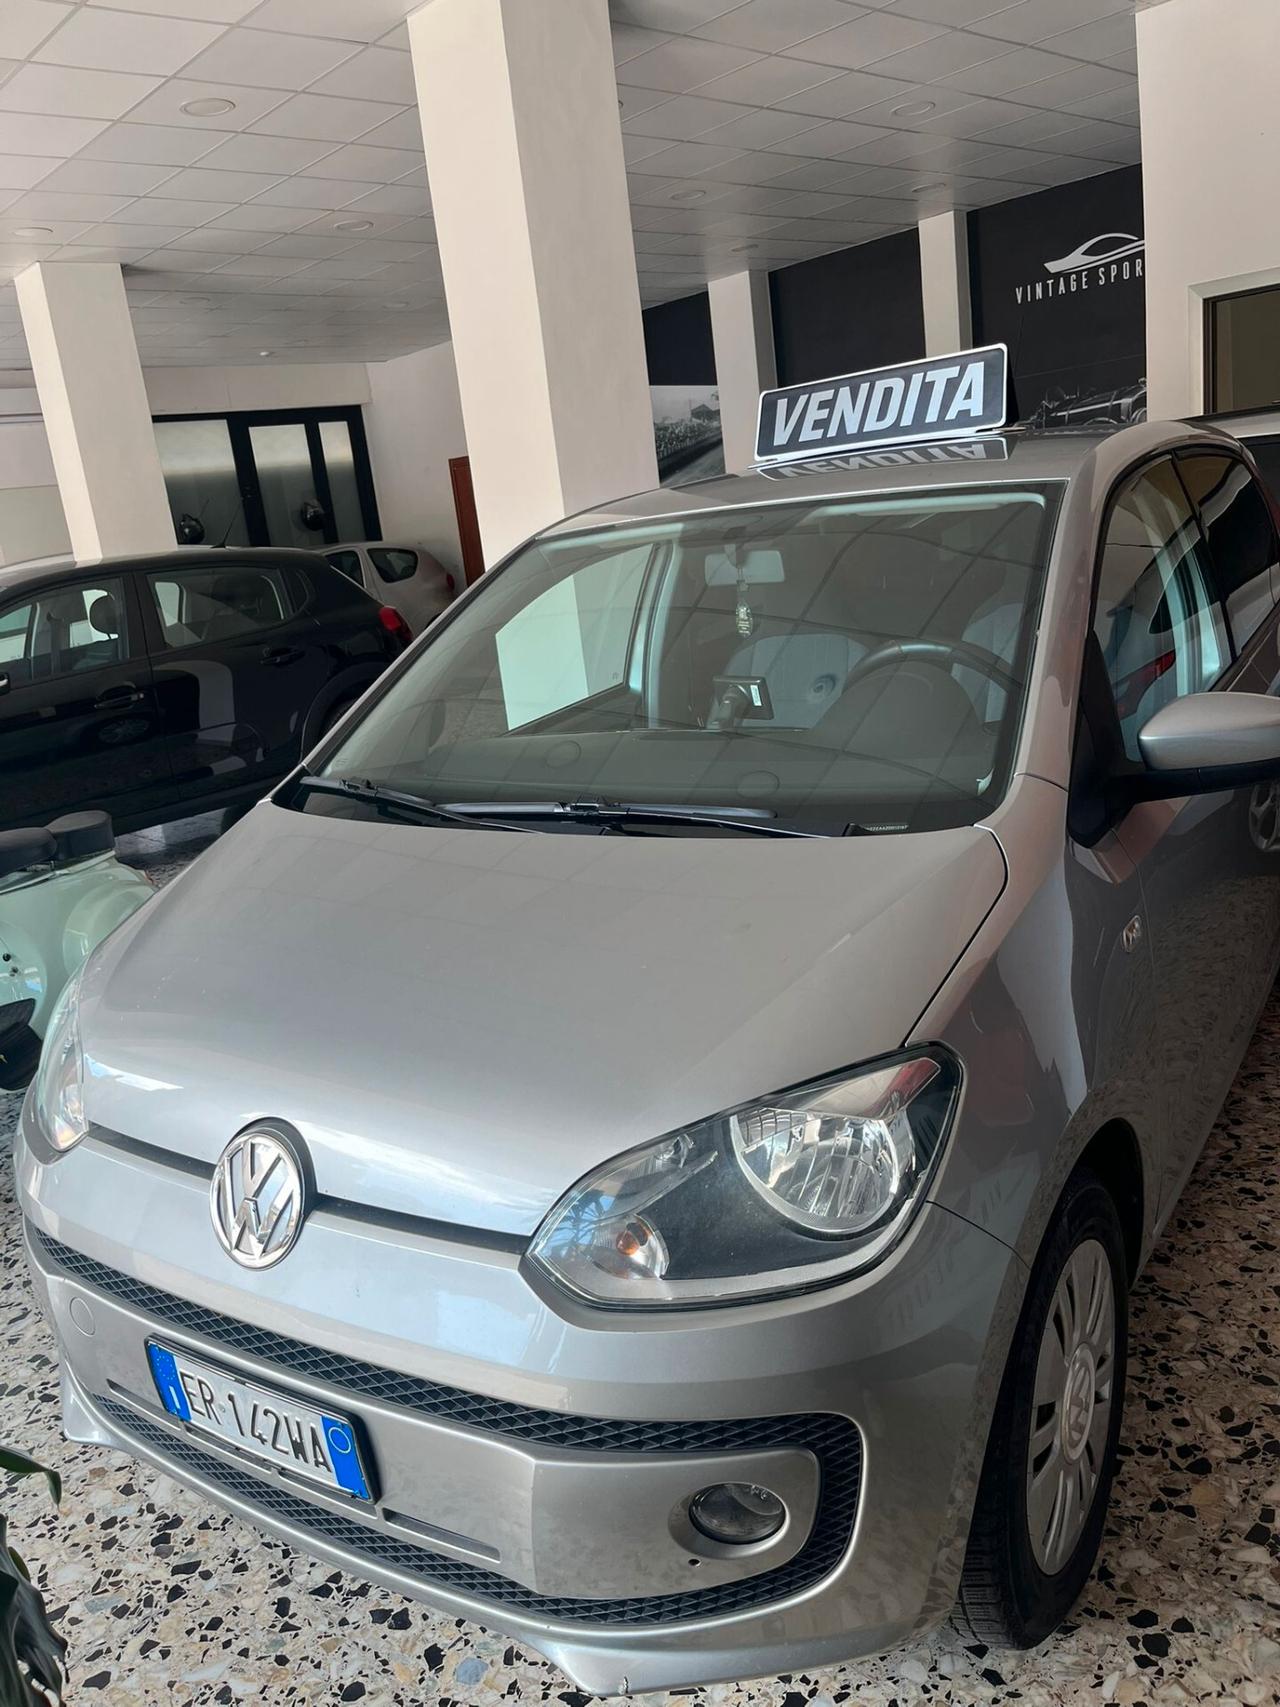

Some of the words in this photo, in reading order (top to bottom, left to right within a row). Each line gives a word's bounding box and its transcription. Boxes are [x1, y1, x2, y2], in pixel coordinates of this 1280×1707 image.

[1015, 271, 1088, 304] VINTAGE
[1098, 258, 1143, 285] SPOR
[773, 361, 985, 446] VENDITA
